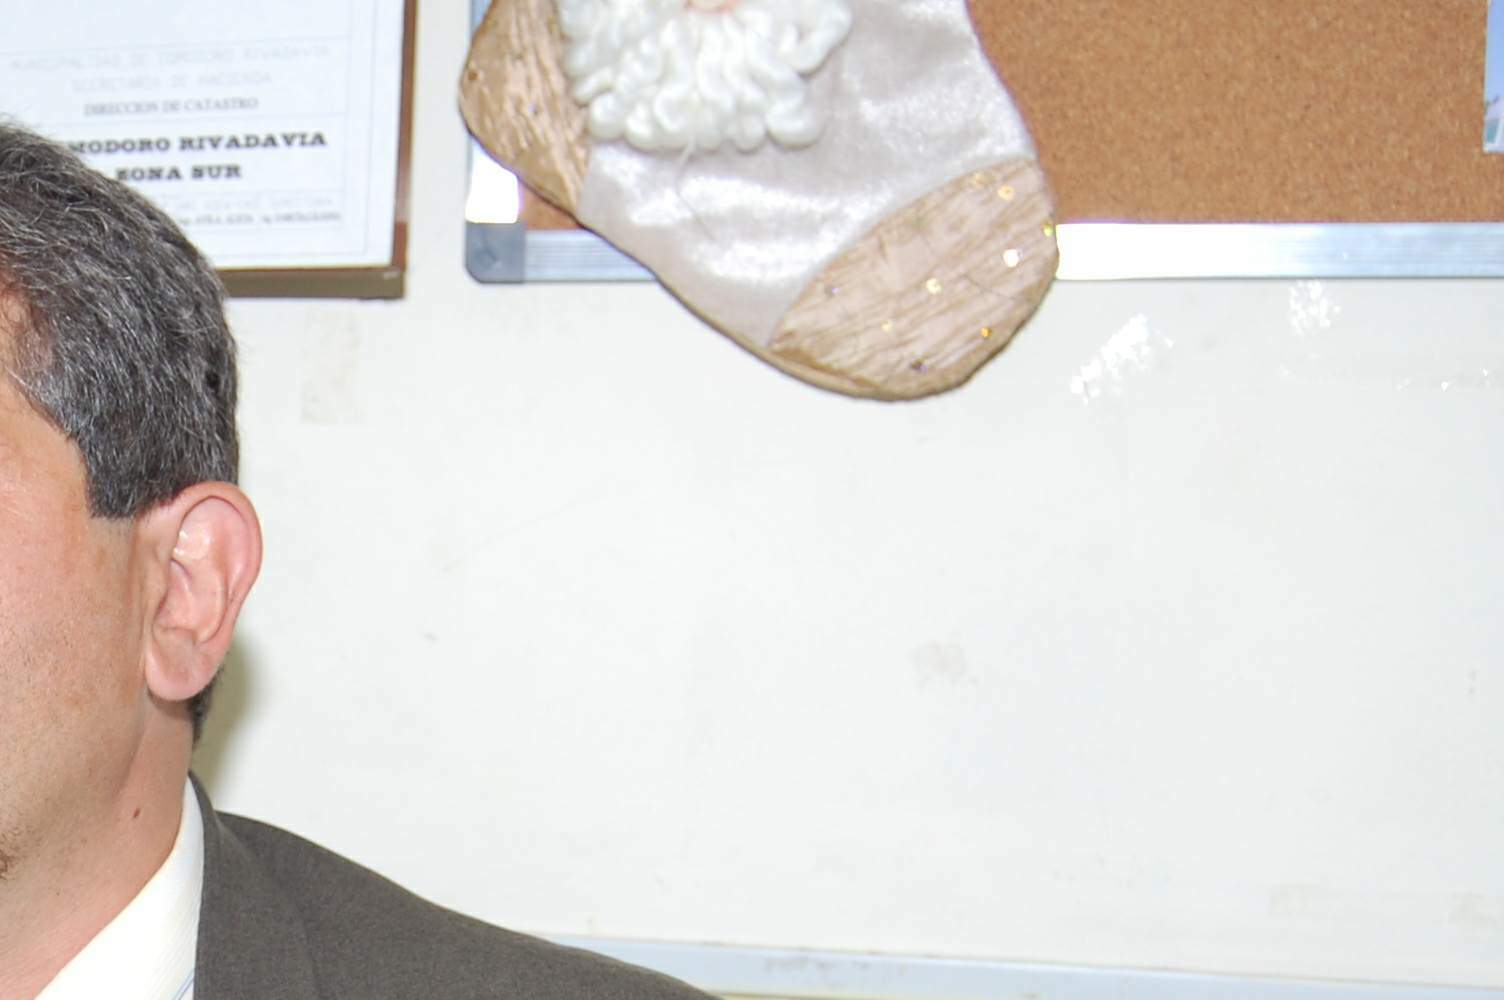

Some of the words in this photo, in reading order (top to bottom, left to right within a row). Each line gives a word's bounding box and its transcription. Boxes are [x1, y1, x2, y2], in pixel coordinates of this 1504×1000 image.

[163, 99, 181, 113] DE
[185, 97, 259, 112] CATASTRO
[69, 138, 171, 155] MODORO
[179, 131, 327, 151] RIVADAVIA
[115, 164, 184, 181] ZONA
[191, 163, 243, 180] SUR
